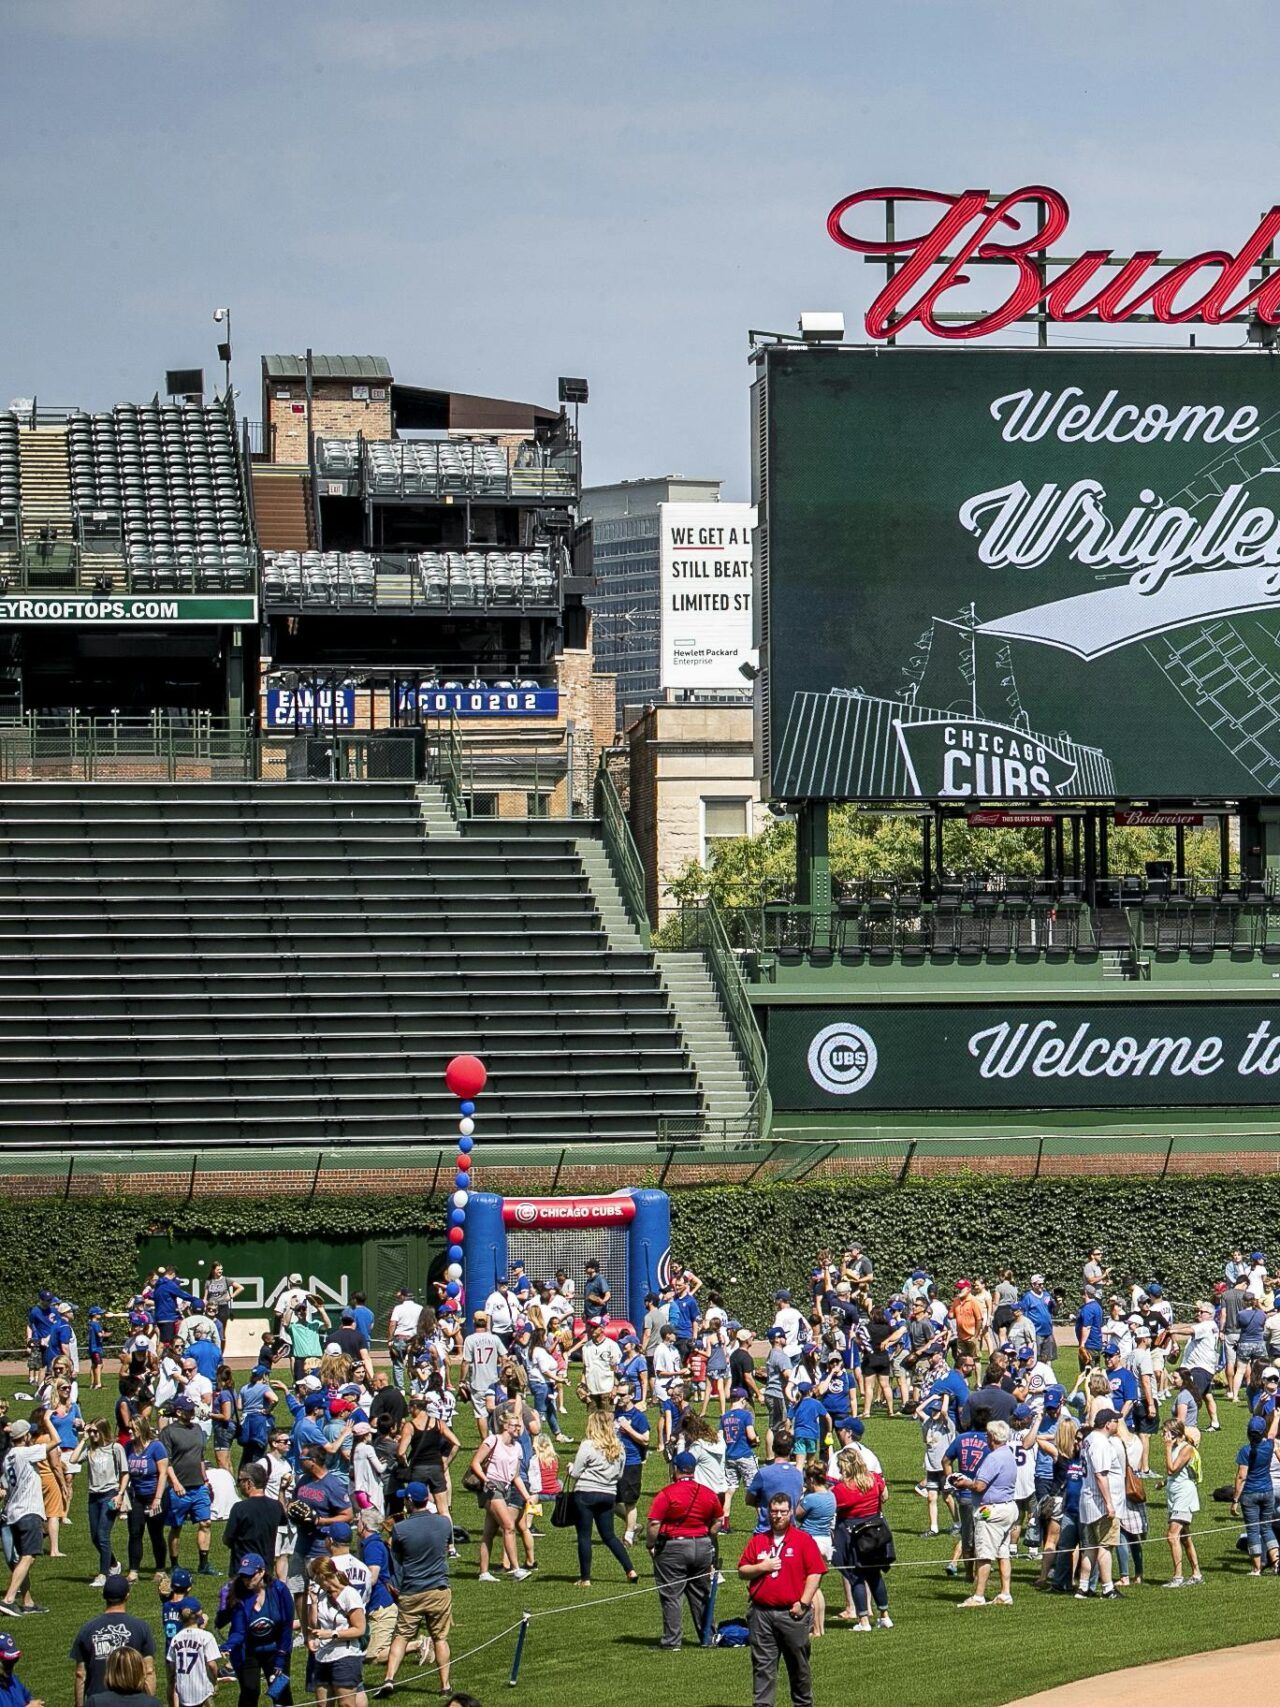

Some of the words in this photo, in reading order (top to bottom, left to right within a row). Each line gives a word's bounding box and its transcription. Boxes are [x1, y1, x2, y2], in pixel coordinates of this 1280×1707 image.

[990, 386, 1262, 443] Welcome
[671, 527, 694, 545] WE
[699, 527, 725, 545] GET
[729, 527, 738, 545] A
[672, 560, 710, 578] STILL
[672, 593, 729, 612] LIMITED
[673, 649, 704, 657] Hewlett
[706, 648, 738, 657] Packard
[673, 657, 713, 666] Enterprise
[944, 726, 1046, 764] CHICAGO
[943, 749, 1050, 796] CUBS
[1124, 811, 1195, 825] Budweiser
[968, 1020, 1225, 1080] Welcome
[540, 1208, 589, 1218] CHICAGO
[477, 1347, 494, 1364] 17
[177, 1651, 199, 1675] 17
